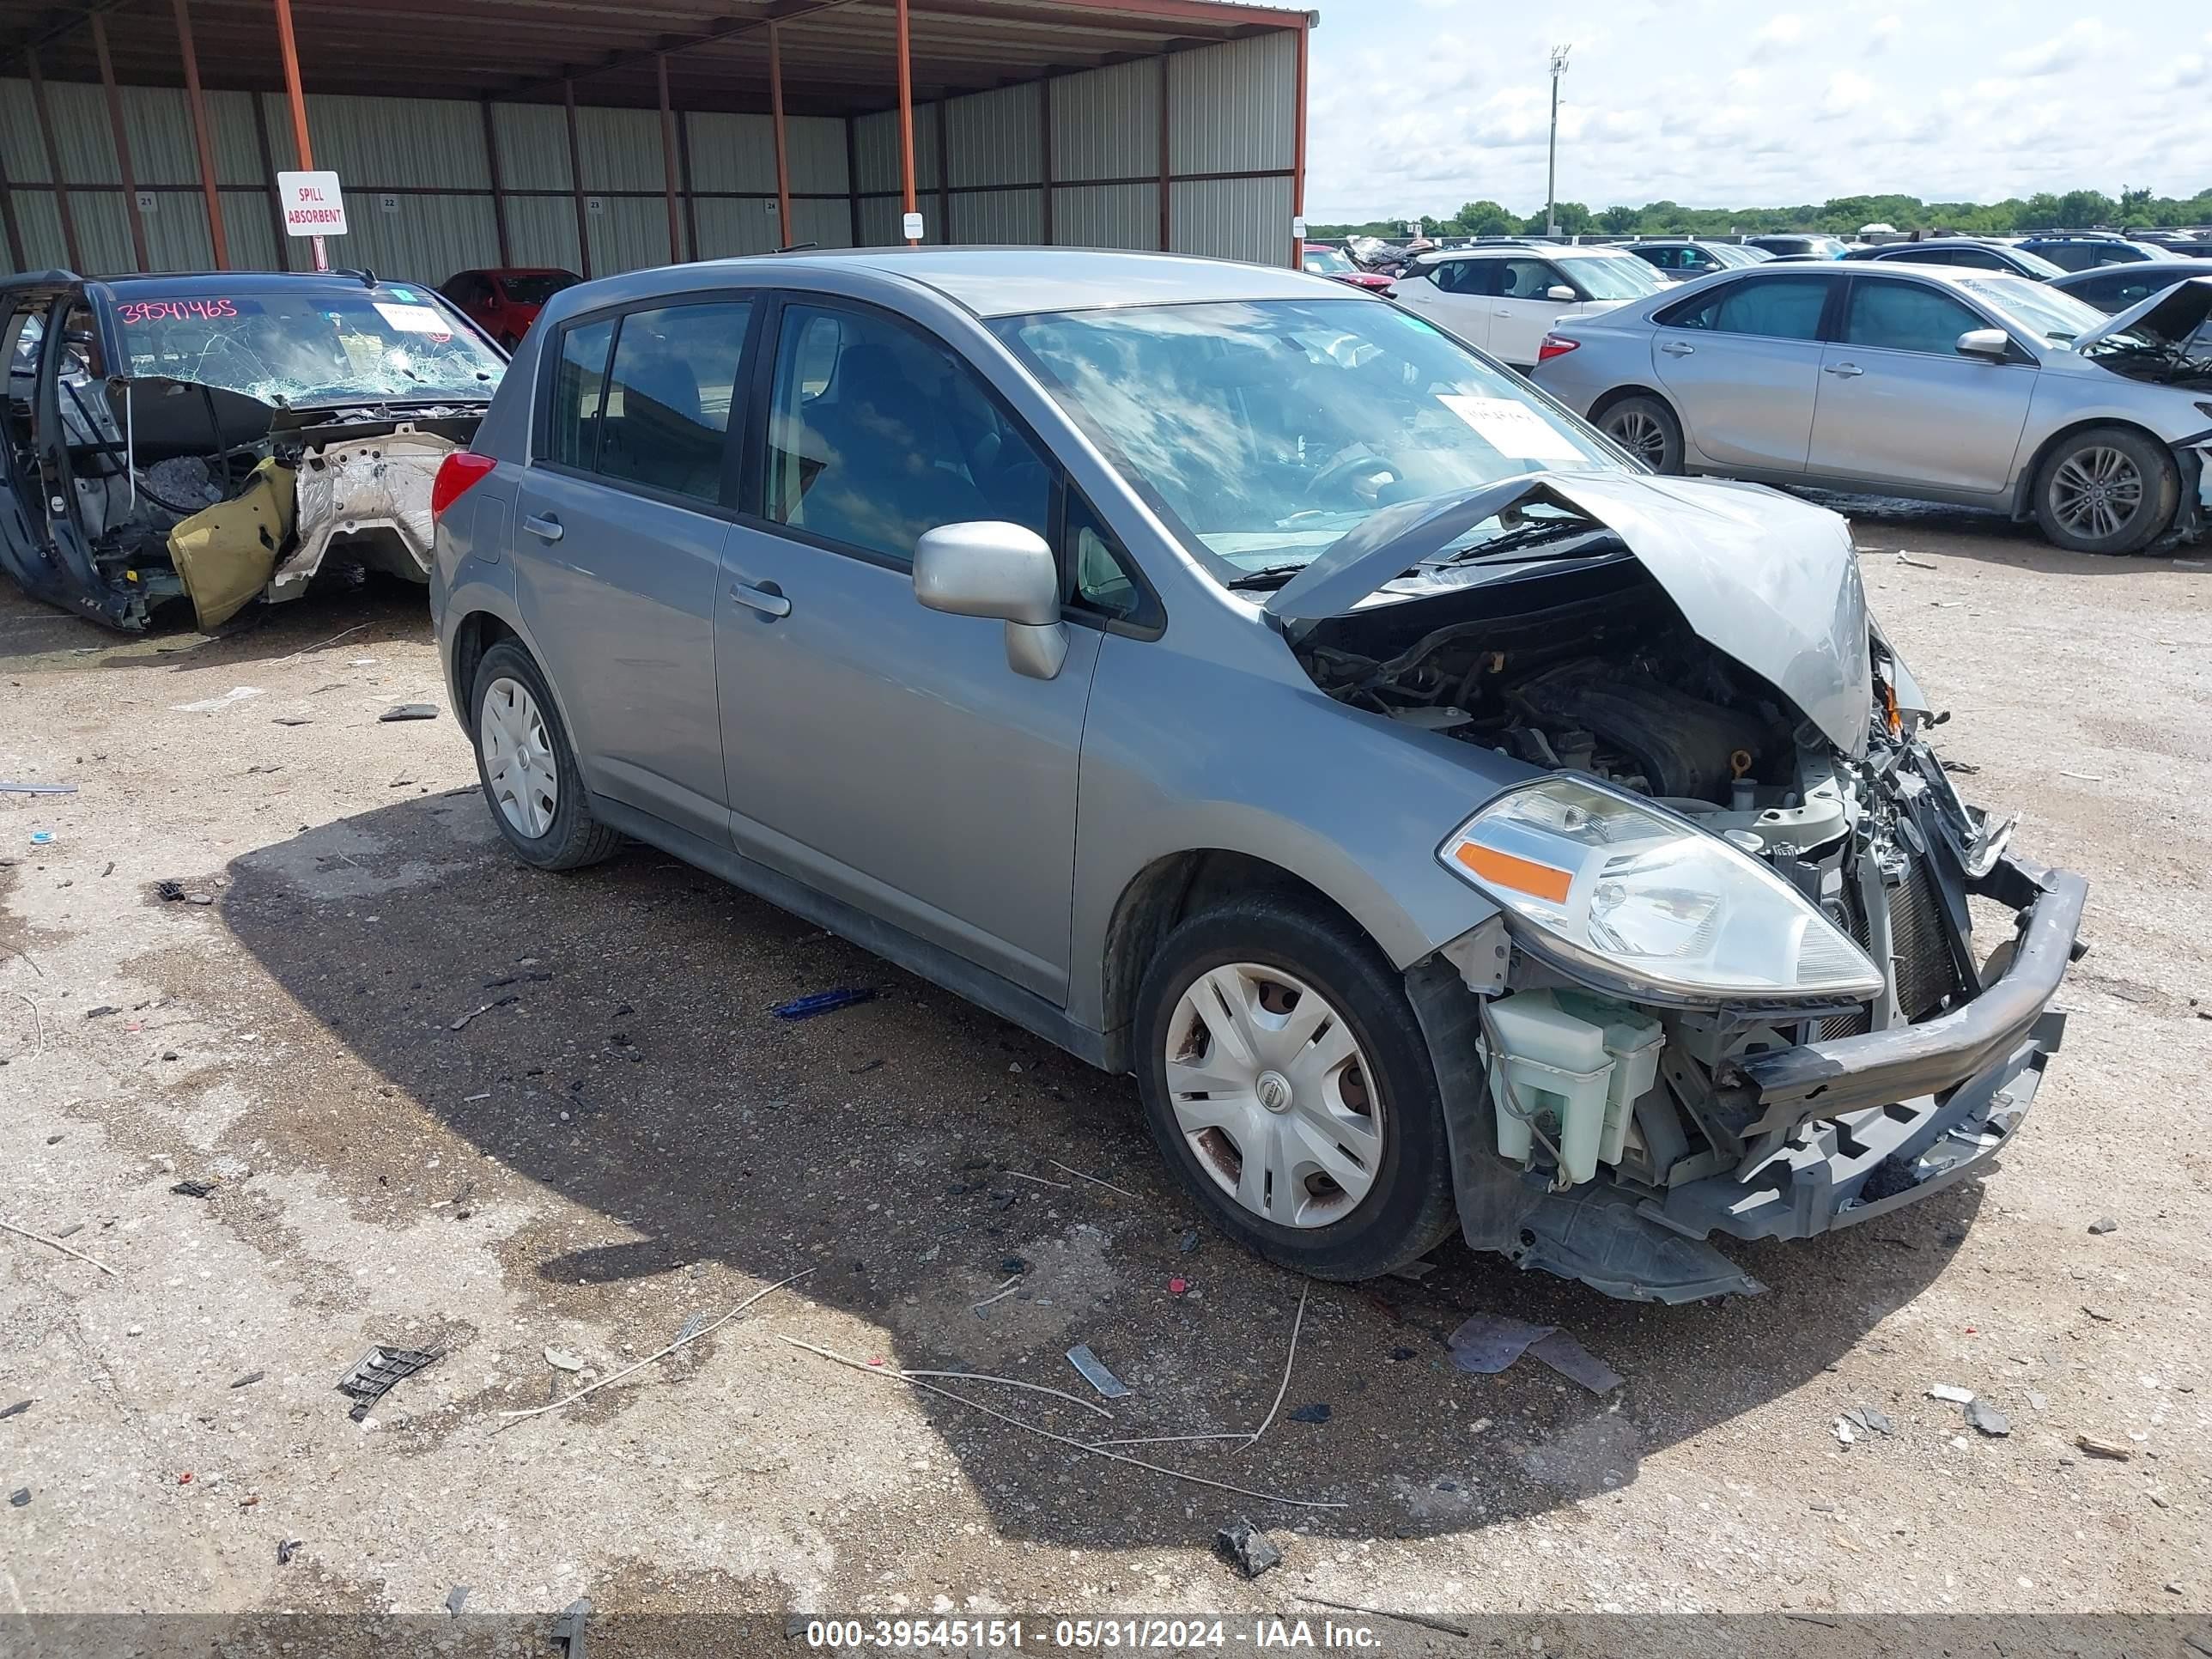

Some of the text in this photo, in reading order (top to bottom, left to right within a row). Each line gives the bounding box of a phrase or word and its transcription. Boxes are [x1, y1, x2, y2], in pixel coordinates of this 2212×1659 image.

[299, 187, 324, 202] SPILL
[140, 198, 152, 206] 21
[384, 198, 395, 207] 22
[289, 209, 342, 224] ABSORBENT
